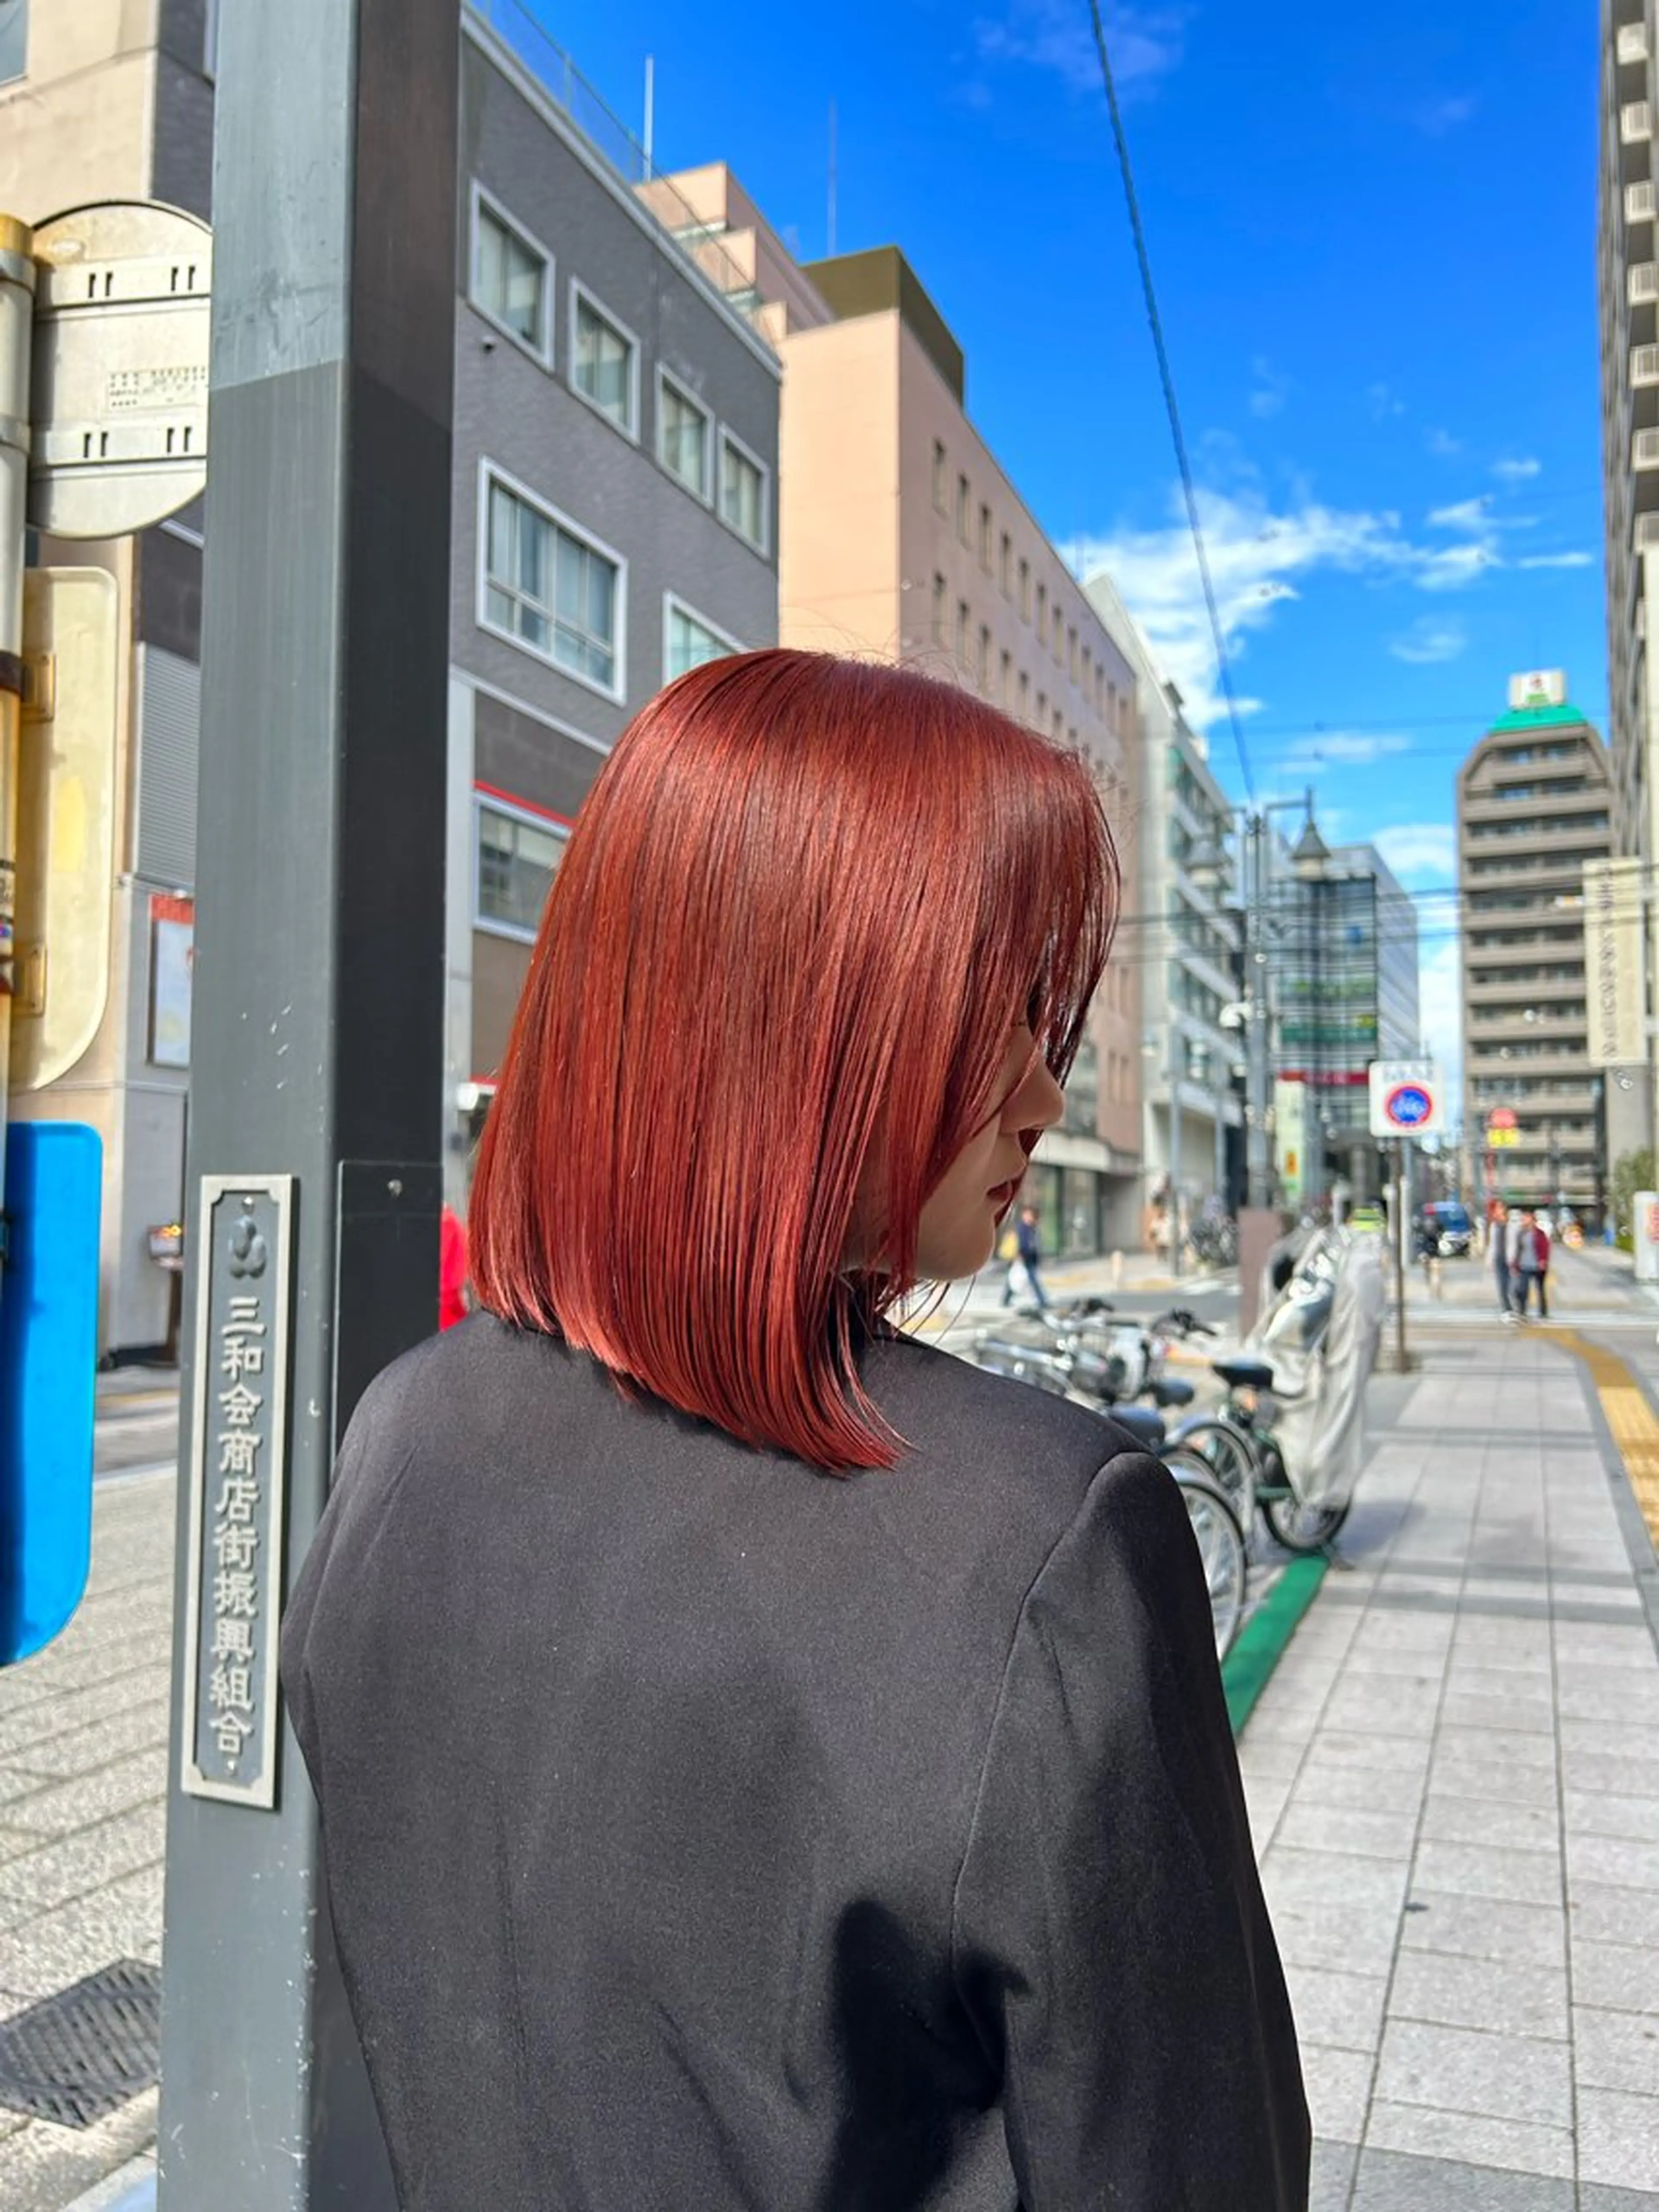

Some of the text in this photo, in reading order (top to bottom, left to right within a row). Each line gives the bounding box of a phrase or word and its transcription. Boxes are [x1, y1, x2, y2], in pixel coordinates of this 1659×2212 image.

[209, 1296, 266, 1753] 三和会商店街振興組合
